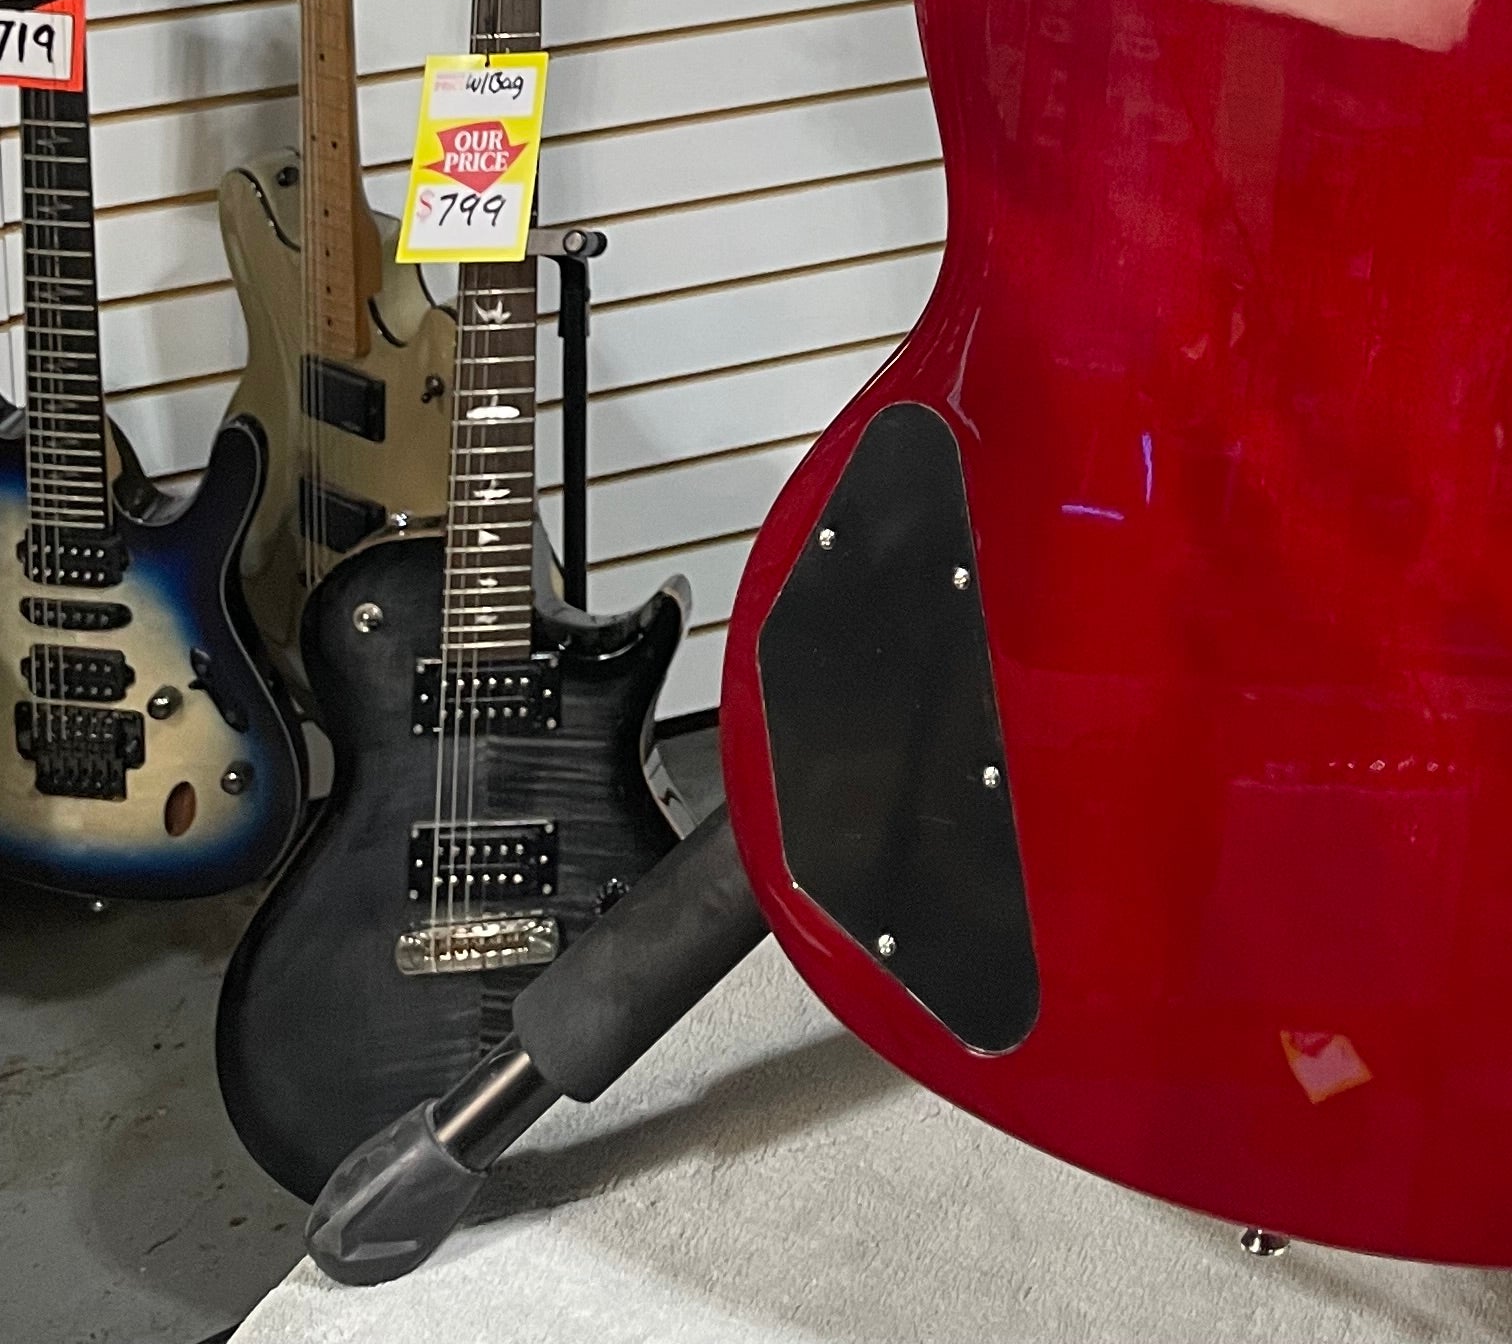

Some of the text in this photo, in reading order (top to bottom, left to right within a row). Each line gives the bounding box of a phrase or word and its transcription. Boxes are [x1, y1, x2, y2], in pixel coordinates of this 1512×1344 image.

[454, 129, 504, 152] OUR
[443, 151, 510, 173] PRICE
[416, 189, 507, 227] $799
